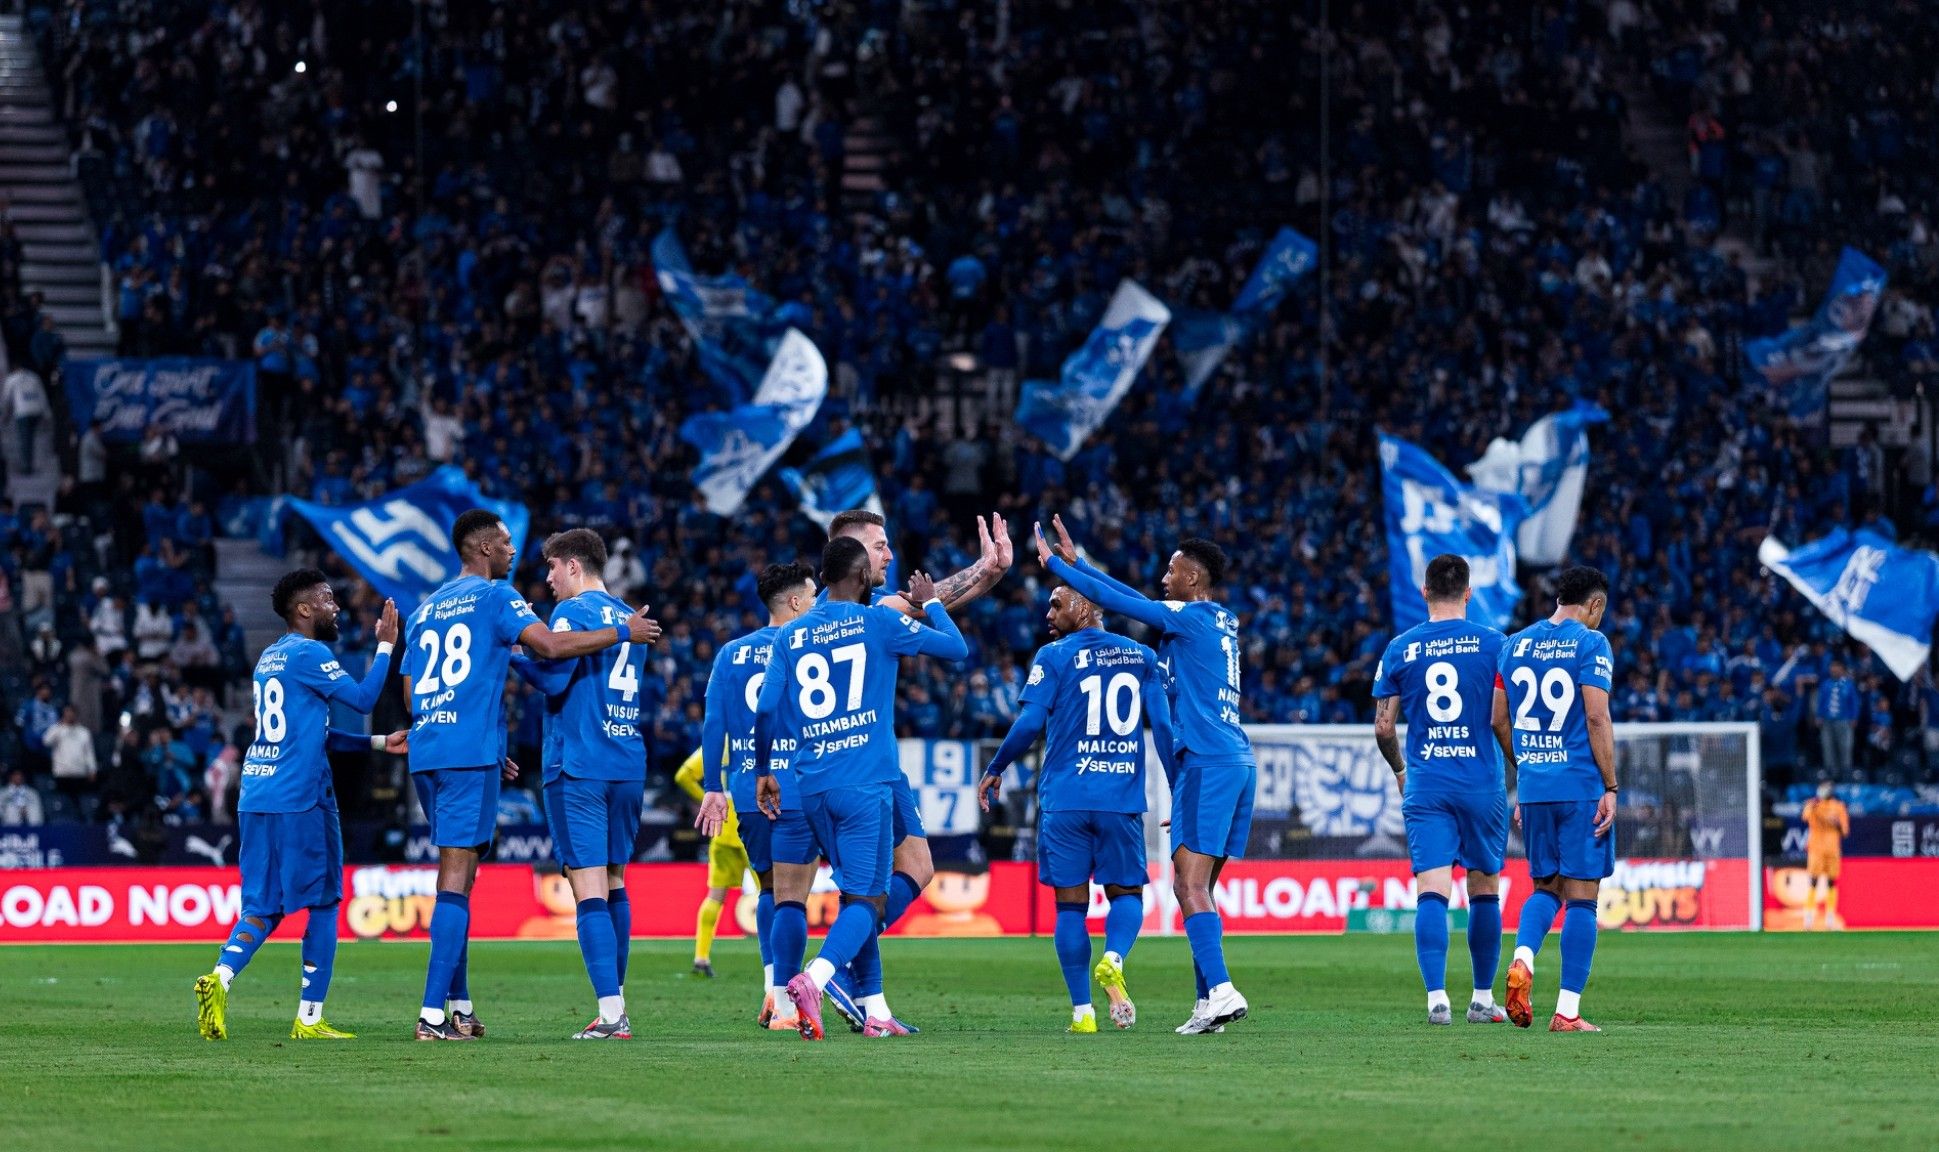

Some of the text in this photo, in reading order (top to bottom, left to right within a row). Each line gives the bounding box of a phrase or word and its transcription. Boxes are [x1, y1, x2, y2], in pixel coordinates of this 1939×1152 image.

[435, 604, 475, 620] Riyad Bank
[812, 615, 864, 635] بنك الرياض
[813, 625, 865, 644] Riyad Bank
[1425, 636, 1480, 648] بنك الرياض
[1426, 645, 1480, 657] Riyad Bank
[414, 623, 471, 694] 28
[1096, 656, 1145, 667] Riyad Bank
[1532, 649, 1576, 660] Riyad Bank
[608, 642, 638, 702] 4
[795, 643, 867, 719] 87
[1425, 662, 1463, 722] 8
[1511, 666, 1575, 732] 29
[607, 704, 639, 720] YUSUF
[1079, 672, 1141, 736] 10
[802, 709, 877, 739] ALTAMBAKTI
[1428, 726, 1469, 739] NEVES
[827, 733, 869, 753] SEVEN
[1077, 740, 1138, 753] MALCOM
[1521, 734, 1563, 749] SALEM
[246, 745, 279, 759] AMAD
[1434, 746, 1476, 757] SEVEN
[1528, 751, 1567, 764] SEVEN
[243, 764, 277, 776] SEVEN
[934, 741, 965, 785] 9
[1089, 761, 1135, 774] SEVEN
[939, 793, 958, 828] 7
[0, 884, 242, 928] OAD NOW
[347, 895, 437, 936] GUY
[1597, 886, 1699, 929] GUYS
